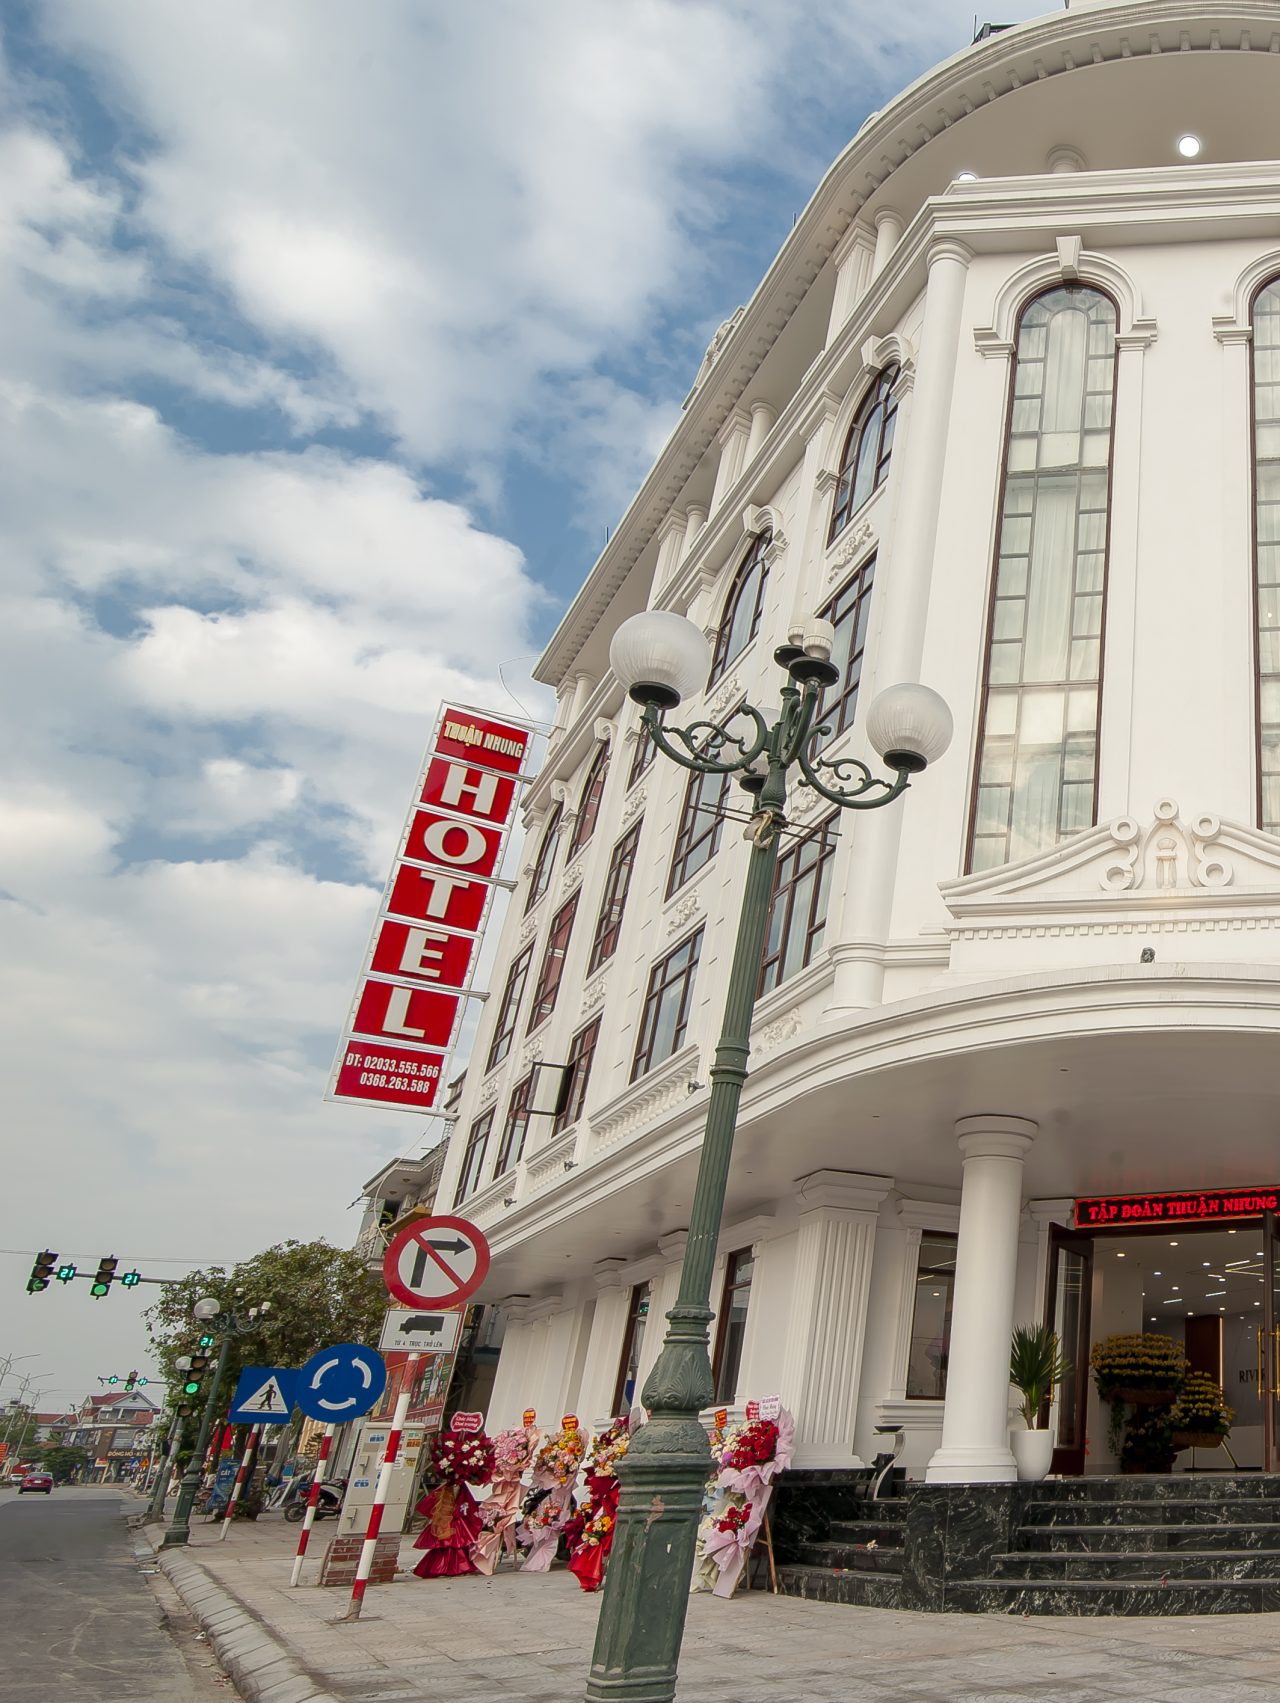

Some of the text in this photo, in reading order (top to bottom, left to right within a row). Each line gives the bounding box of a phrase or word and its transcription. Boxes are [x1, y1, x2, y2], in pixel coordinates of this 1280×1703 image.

[444, 721, 524, 759] THUẬN NHUNG
[382, 763, 499, 1038] HOTEL
[346, 1053, 440, 1078] ĐT: 02033.555.566
[360, 1072, 430, 1094] 0368.263.588
[1088, 1203, 1117, 1222] TẬP
[1167, 1197, 1219, 1216] THUẬN
[1223, 1196, 1278, 1213] NHUNG
